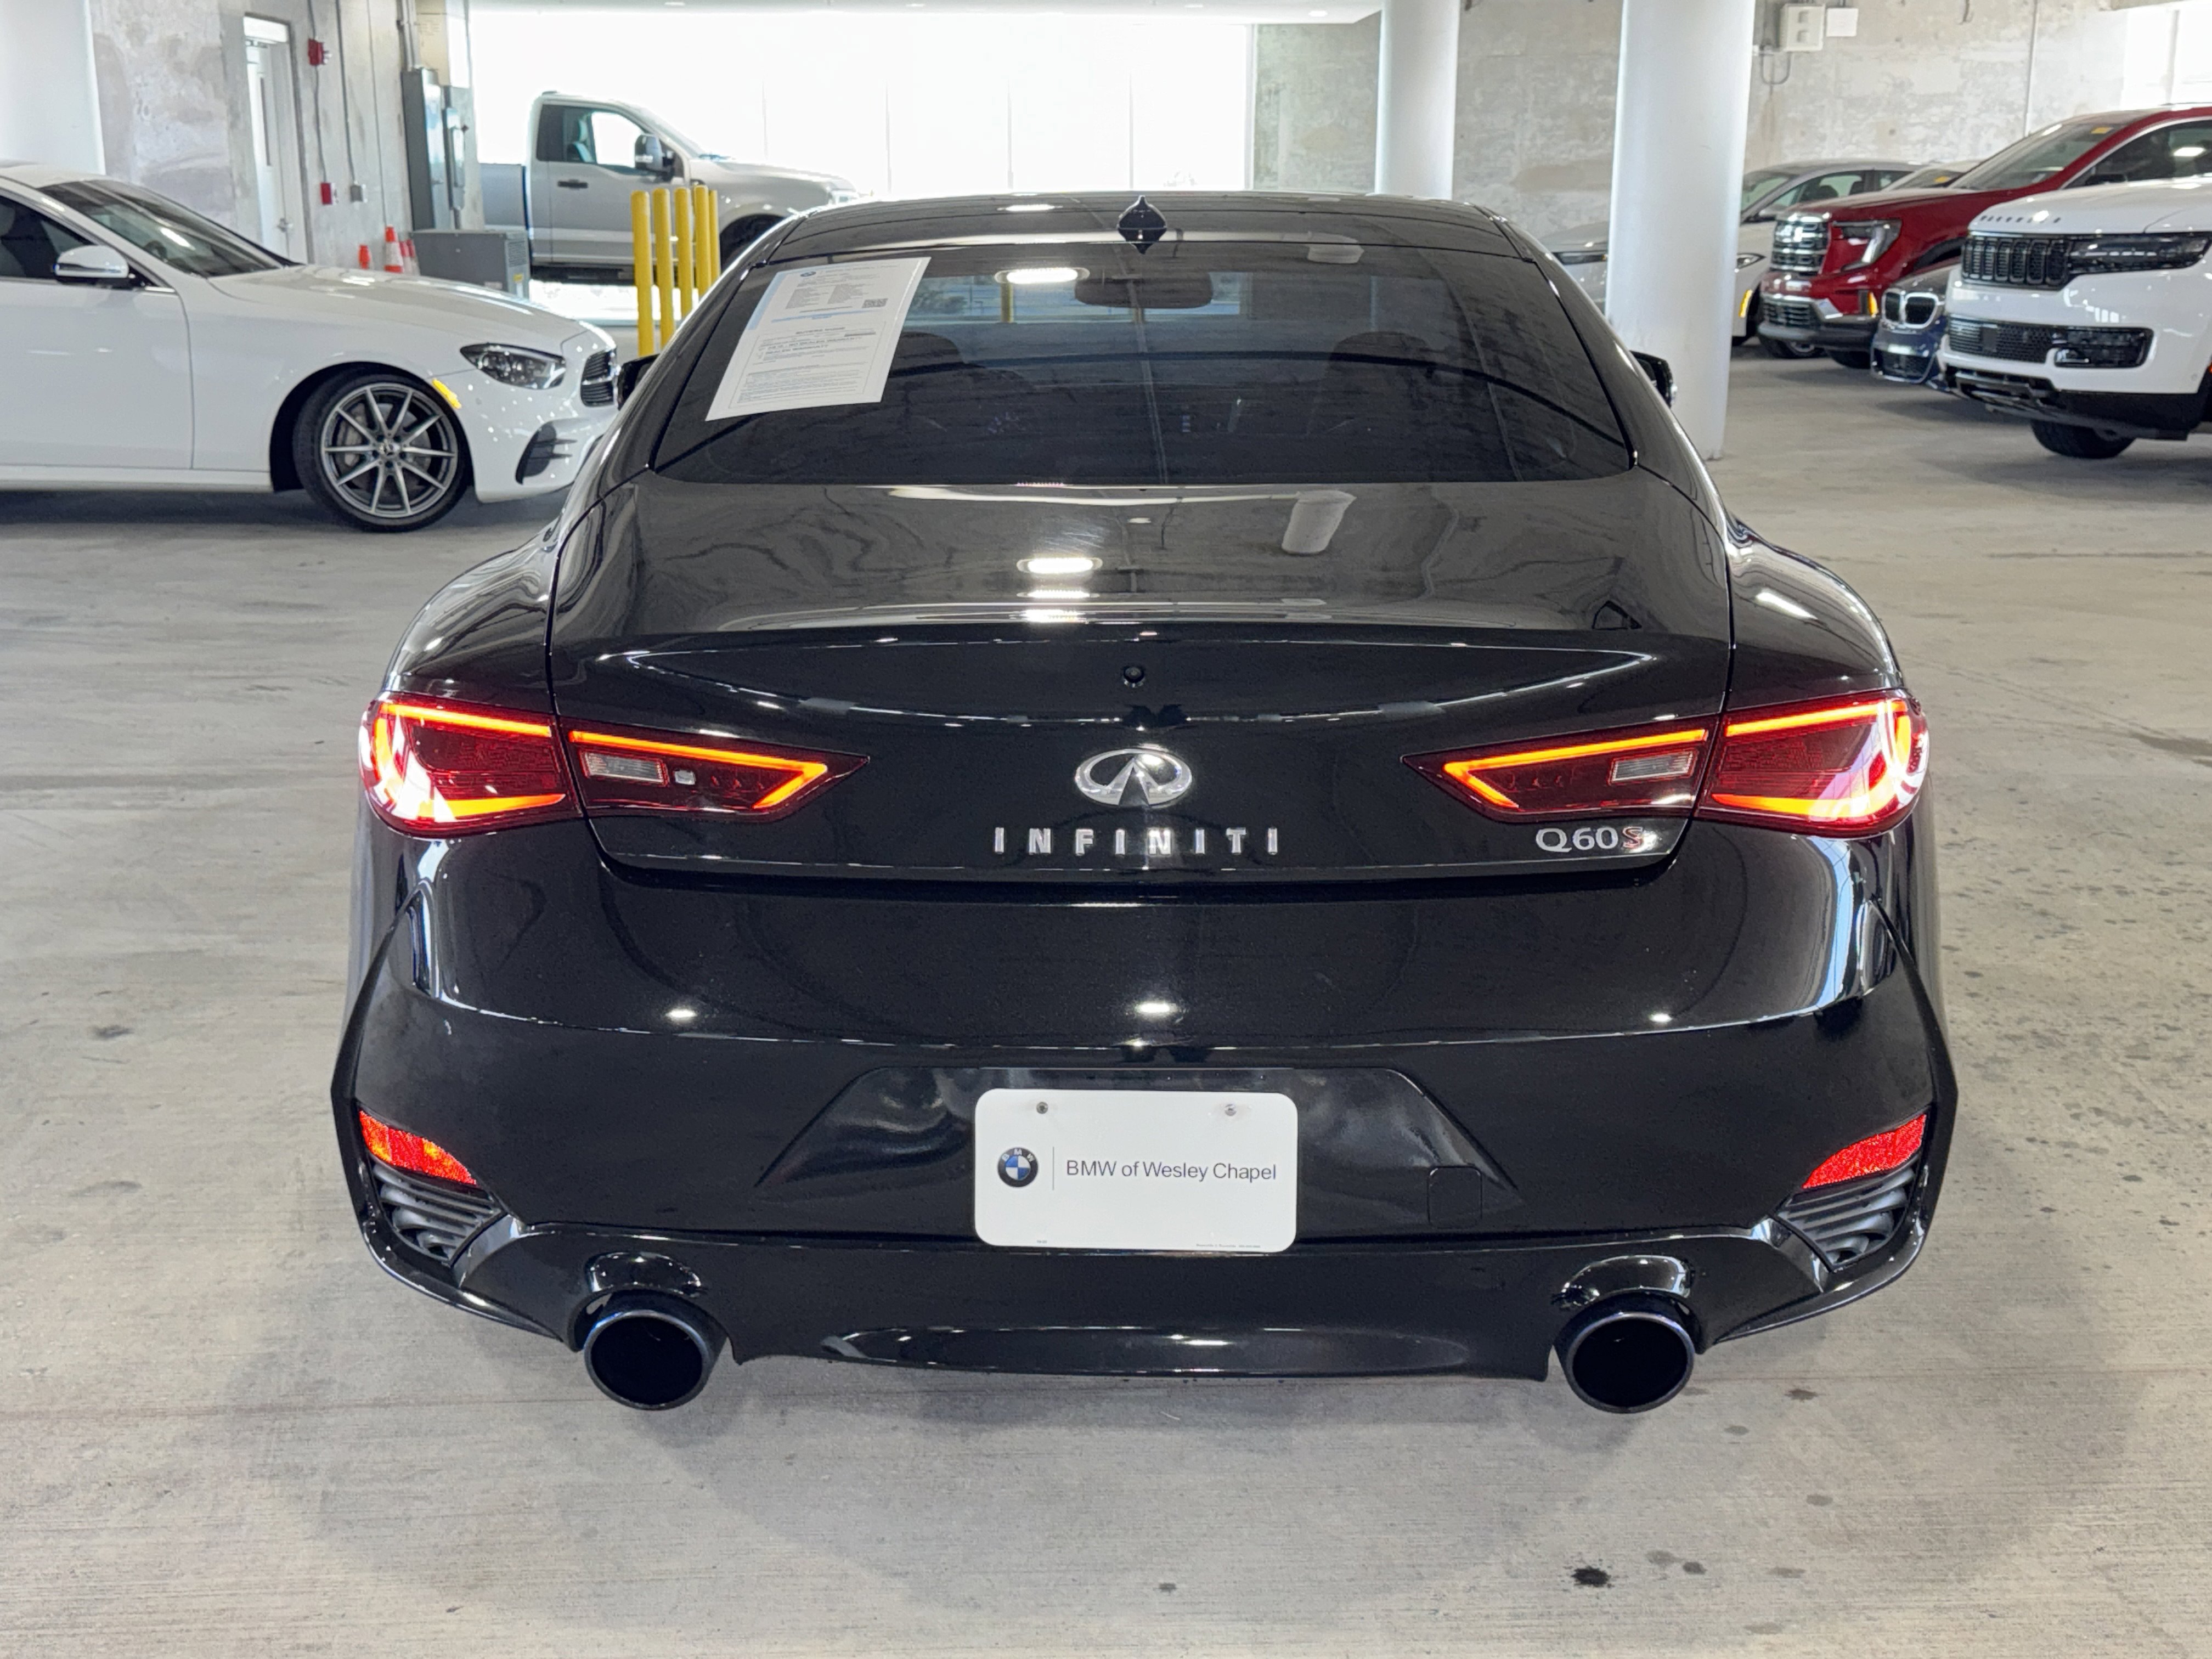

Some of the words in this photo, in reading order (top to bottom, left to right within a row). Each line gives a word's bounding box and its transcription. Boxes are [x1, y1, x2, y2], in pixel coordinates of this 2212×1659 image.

[994, 827, 1278, 855] INFINITI
[1001, 1148, 1035, 1162] BMW
[1066, 1160, 1117, 1176] BMW
[1121, 1161, 1139, 1176] of
[1143, 1161, 1208, 1182] Wesley
[1213, 1163, 1277, 1183] Chapel
